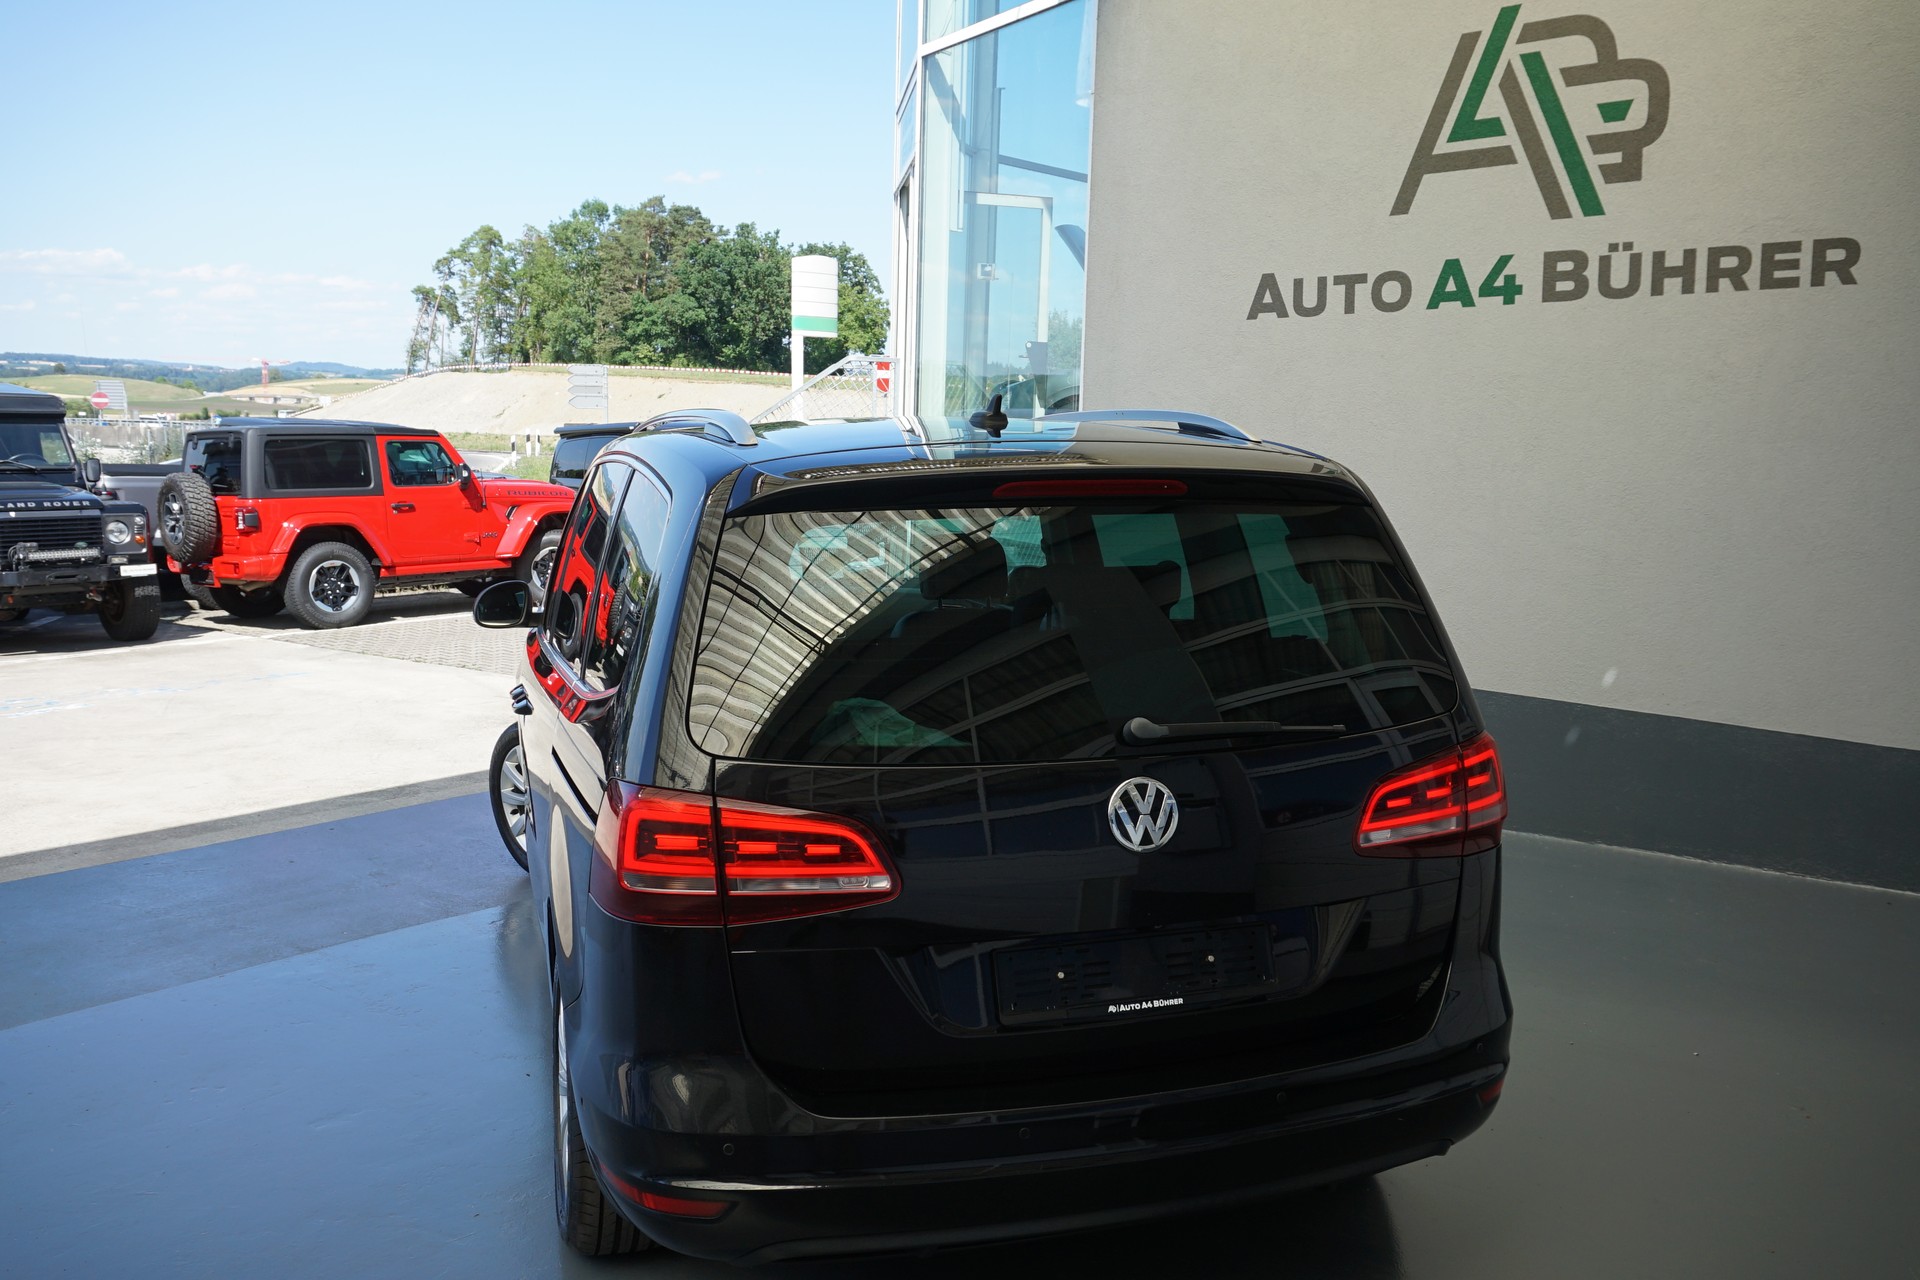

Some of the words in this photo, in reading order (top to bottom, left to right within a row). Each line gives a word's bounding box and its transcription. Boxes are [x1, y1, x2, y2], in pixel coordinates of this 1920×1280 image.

[1246, 270, 1413, 320] AUTO
[1426, 254, 1524, 310] A4
[1541, 237, 1862, 304] BÜHRER
[1119, 1003, 1141, 1012] AUTO
[1141, 1001, 1153, 1009] A4
